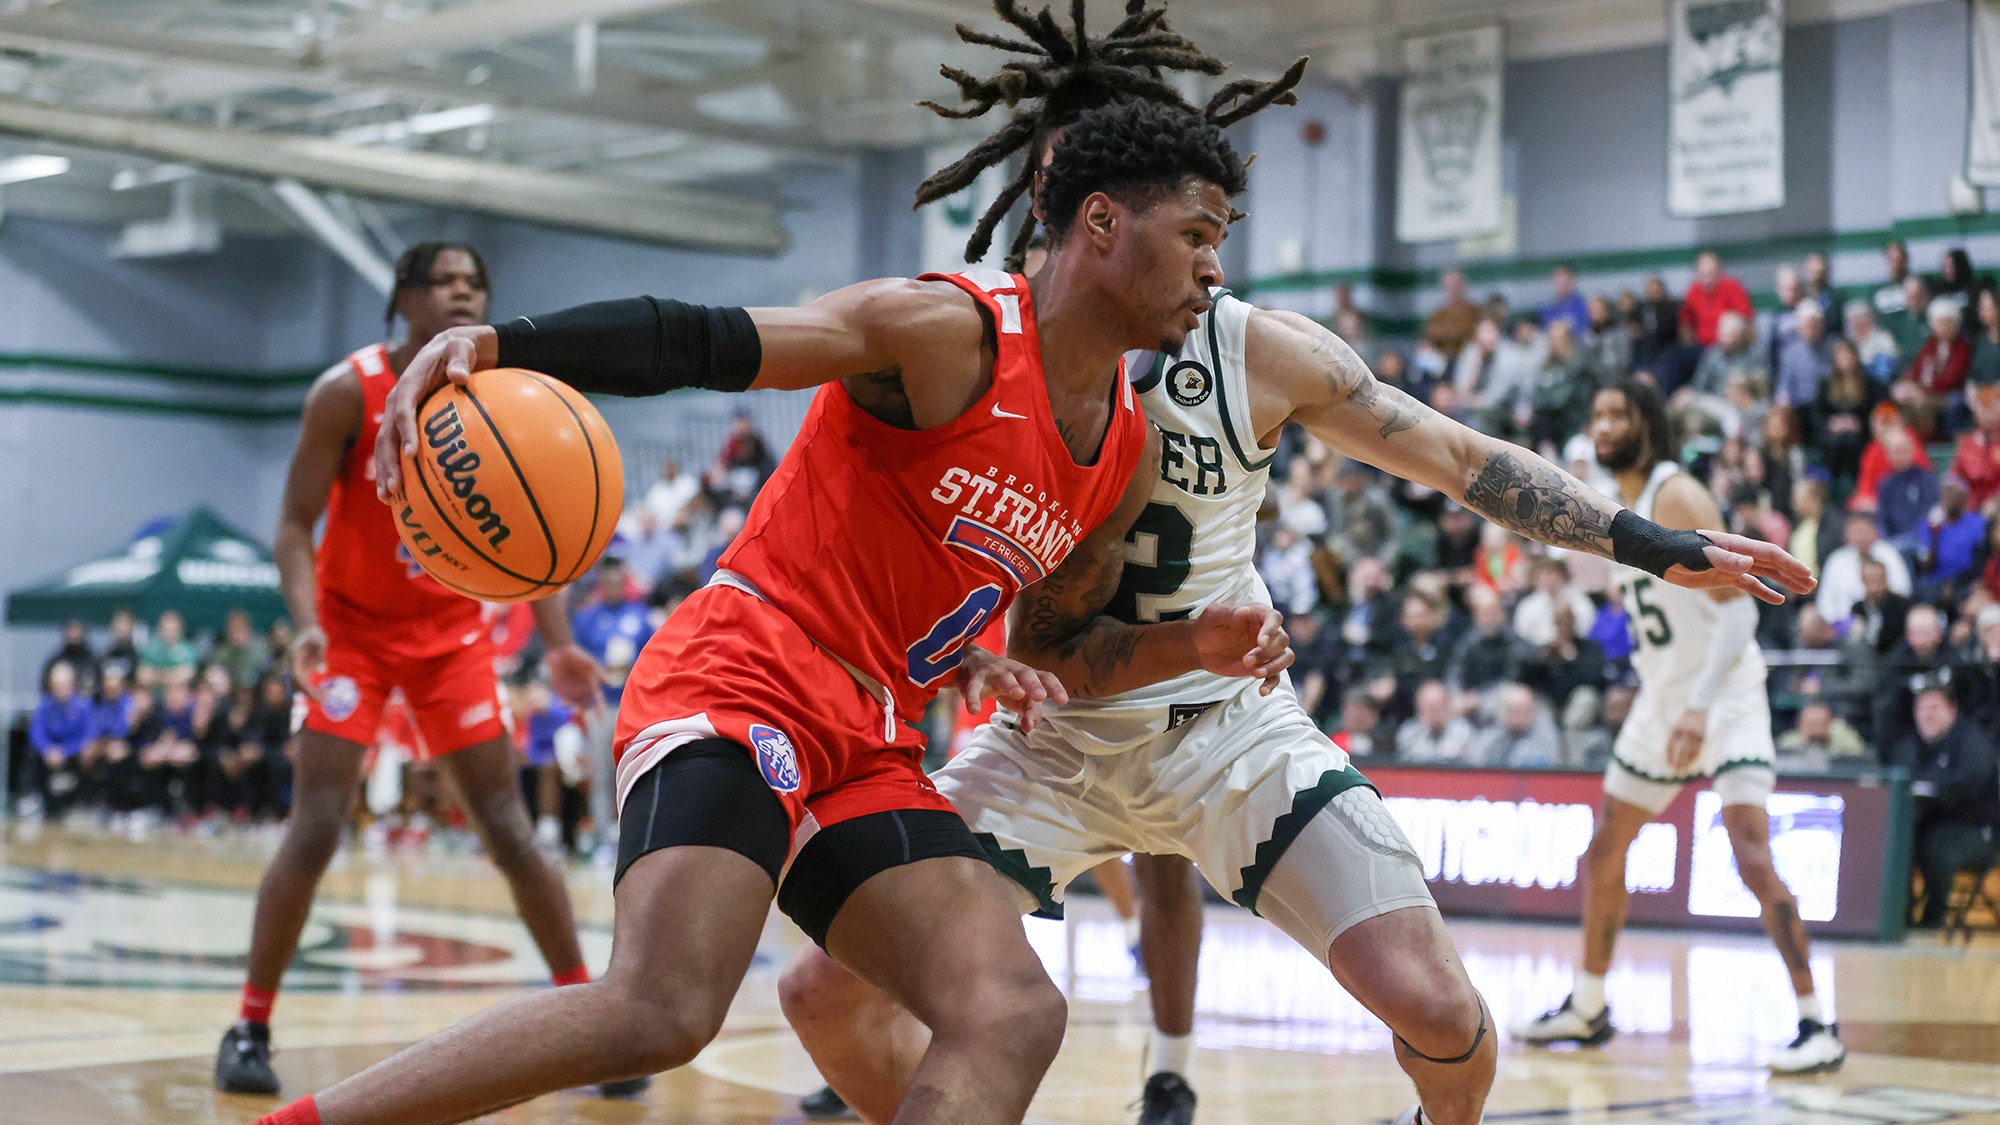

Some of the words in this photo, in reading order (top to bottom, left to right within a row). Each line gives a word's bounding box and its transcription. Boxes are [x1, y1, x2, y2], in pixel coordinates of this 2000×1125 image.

[424, 401, 510, 552] Wilson
[1160, 430, 1227, 494] ER
[986, 466, 1082, 537] BROOKLYN
[441, 553, 470, 571] NXT
[984, 536, 1030, 575] TERRIERS
[1101, 502, 1197, 624] 2
[906, 583, 1003, 689] 0
[1620, 578, 1673, 650] 5
